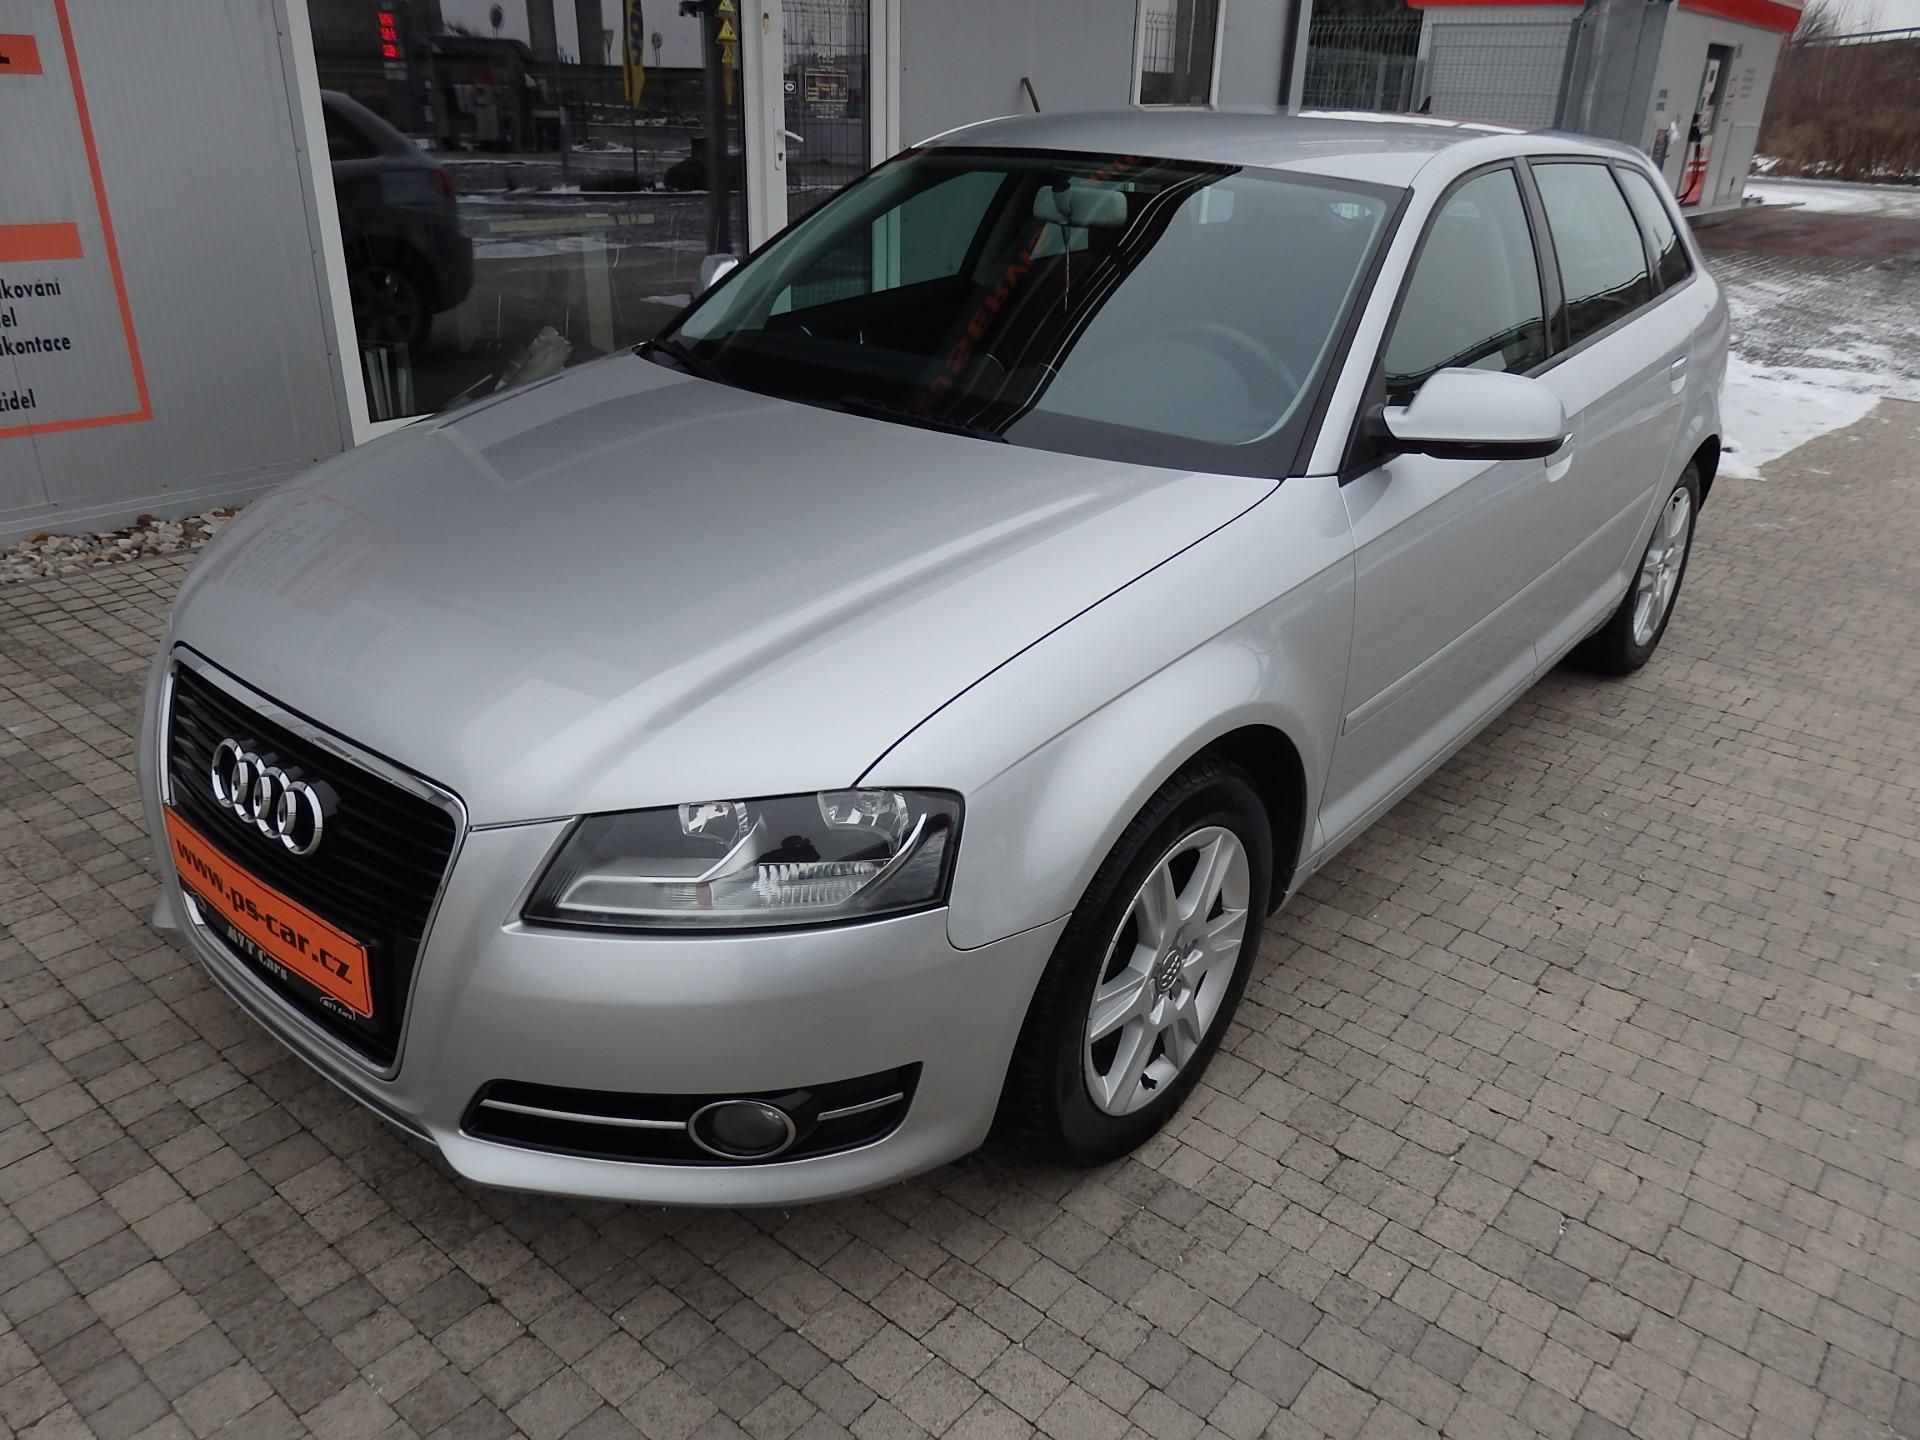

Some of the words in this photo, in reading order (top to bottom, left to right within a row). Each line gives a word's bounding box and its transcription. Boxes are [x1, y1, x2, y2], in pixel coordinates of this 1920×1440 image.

[0, 277, 61, 299] kování
[0, 306, 17, 329] el
[176, 837, 354, 985] www.ps-car.cz
